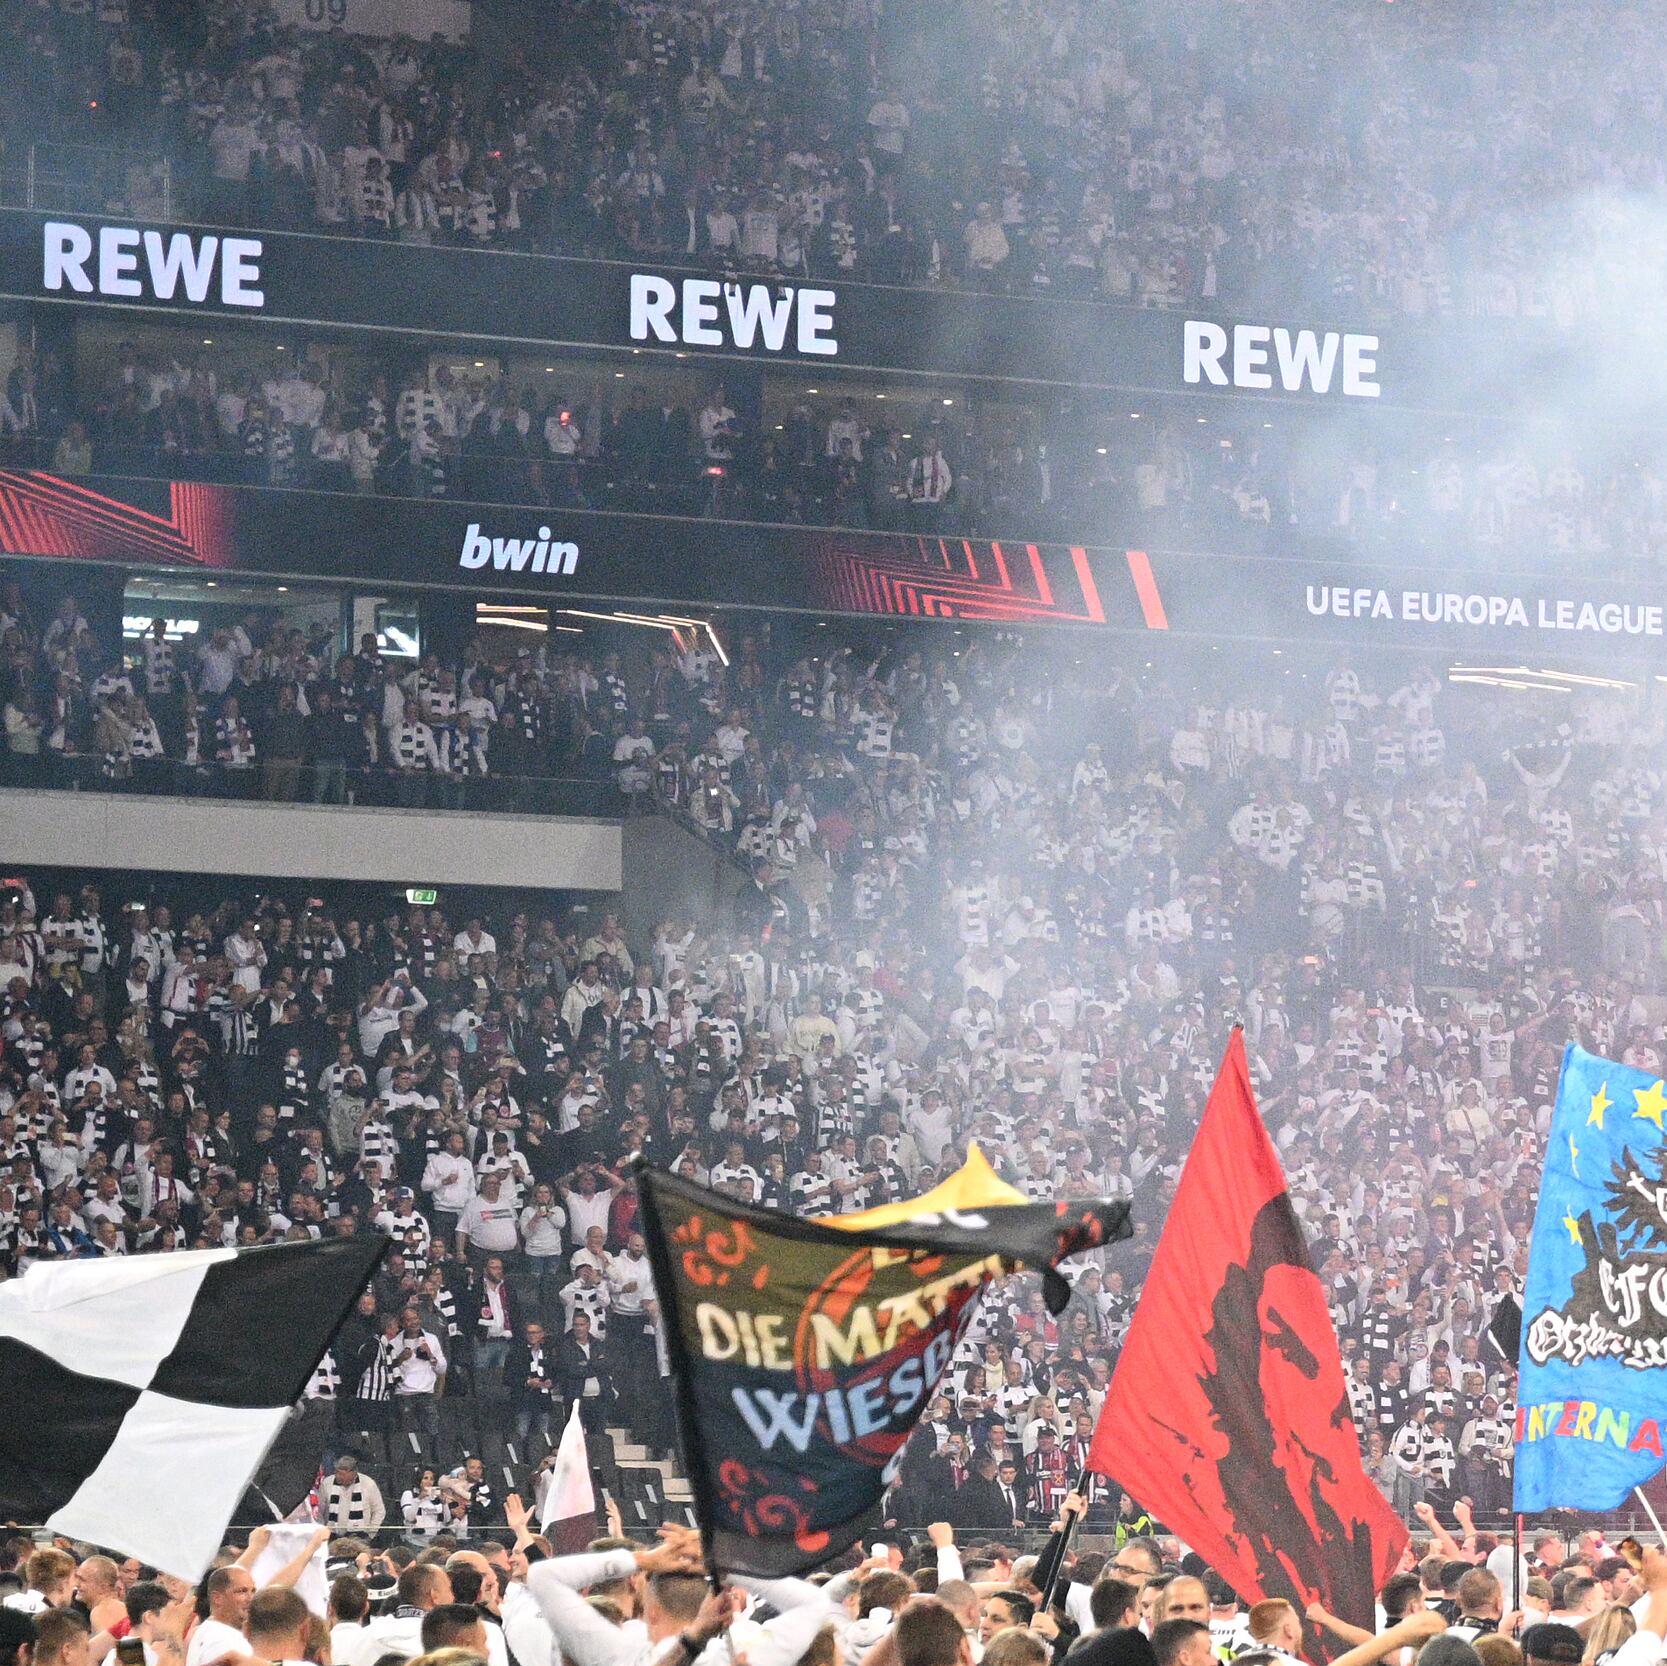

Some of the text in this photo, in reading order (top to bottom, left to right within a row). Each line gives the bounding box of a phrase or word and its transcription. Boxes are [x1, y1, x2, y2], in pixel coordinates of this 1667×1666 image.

[44, 222, 264, 306] REWE
[629, 274, 838, 355] REWE
[1184, 320, 1380, 397] REWE
[459, 523, 579, 576] bwin
[1306, 585, 1393, 621] UEFA
[1402, 592, 1529, 629] EUROPA
[696, 1302, 793, 1371] DIE
